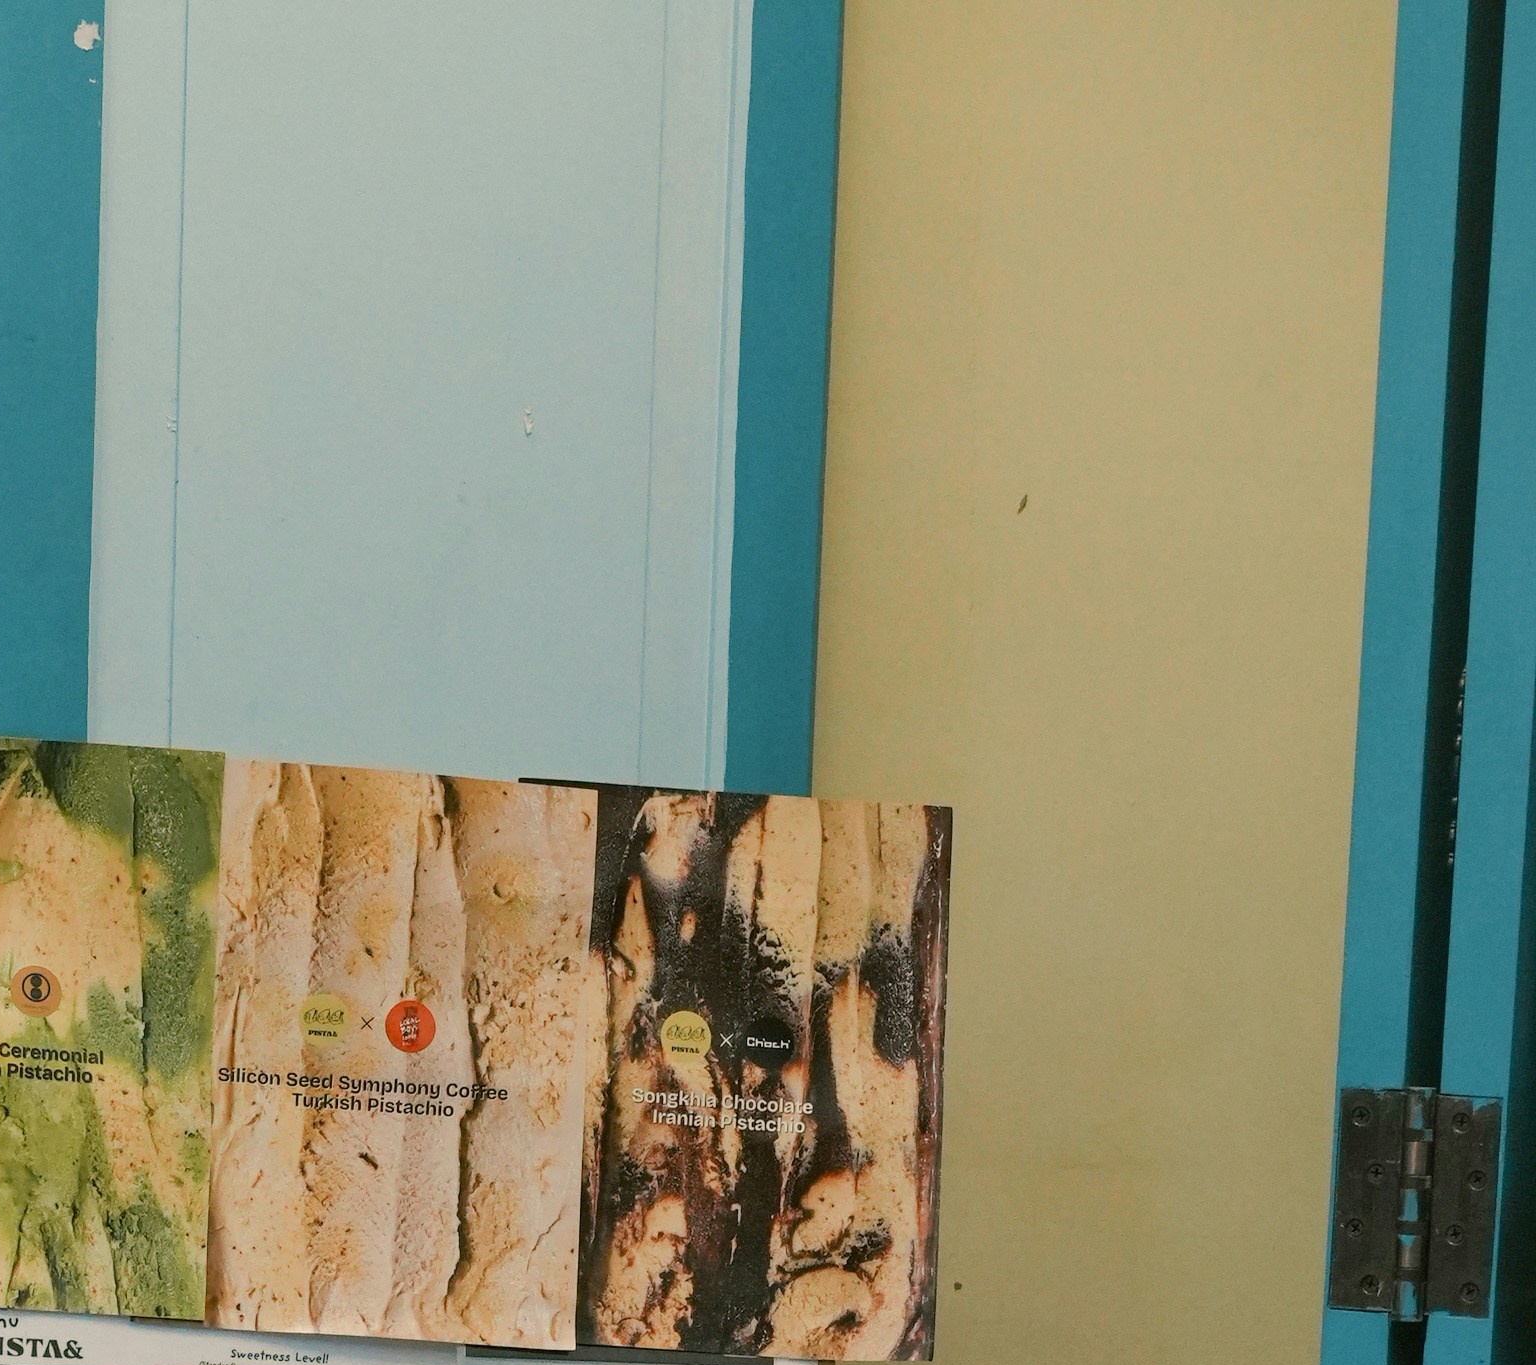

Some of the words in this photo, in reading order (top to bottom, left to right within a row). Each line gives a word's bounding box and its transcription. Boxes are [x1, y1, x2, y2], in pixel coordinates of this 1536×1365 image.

[7, 1063, 93, 1084] Pistachio
[218, 1067, 281, 1085] Silicon
[286, 1072, 334, 1089] Seed
[339, 1076, 440, 1099] Symphony
[446, 1083, 508, 1100] Coffee
[292, 1093, 362, 1111] Turkish
[368, 1098, 454, 1117] Pistachio
[631, 1088, 717, 1108] Songkhla
[721, 1095, 814, 1115] Chocolate
[652, 1110, 716, 1128] Iranian
[720, 1115, 805, 1133] Pistachio
[230, 1349, 291, 1362] Sweetness
[295, 1352, 329, 1364] Level!
